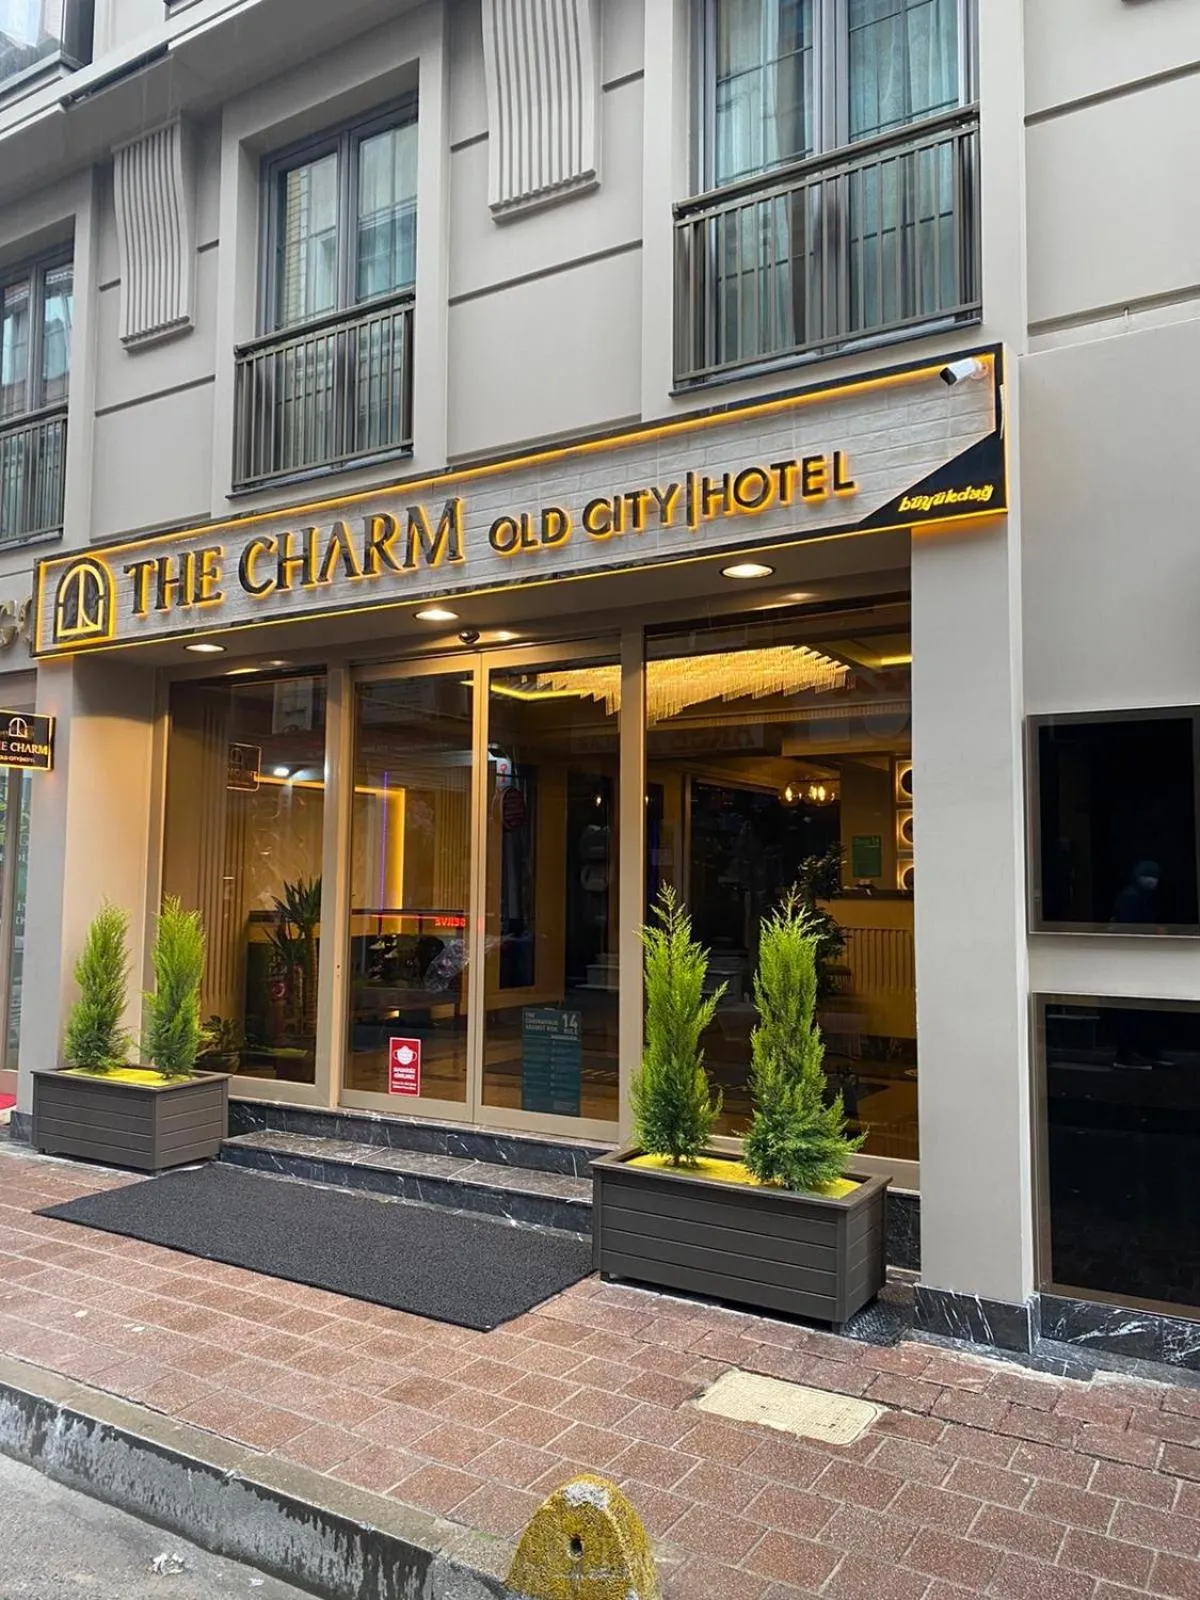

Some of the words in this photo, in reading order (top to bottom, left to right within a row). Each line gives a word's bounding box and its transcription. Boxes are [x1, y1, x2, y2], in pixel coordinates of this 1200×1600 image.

[489, 506, 571, 555] OLD
[582, 485, 680, 536] CITY
[702, 451, 856, 514] HOTEL
[123, 545, 223, 615] THE
[238, 498, 464, 597] CHARM
[10, 742, 48, 755] CHARM
[562, 1013, 578, 1028] 14
